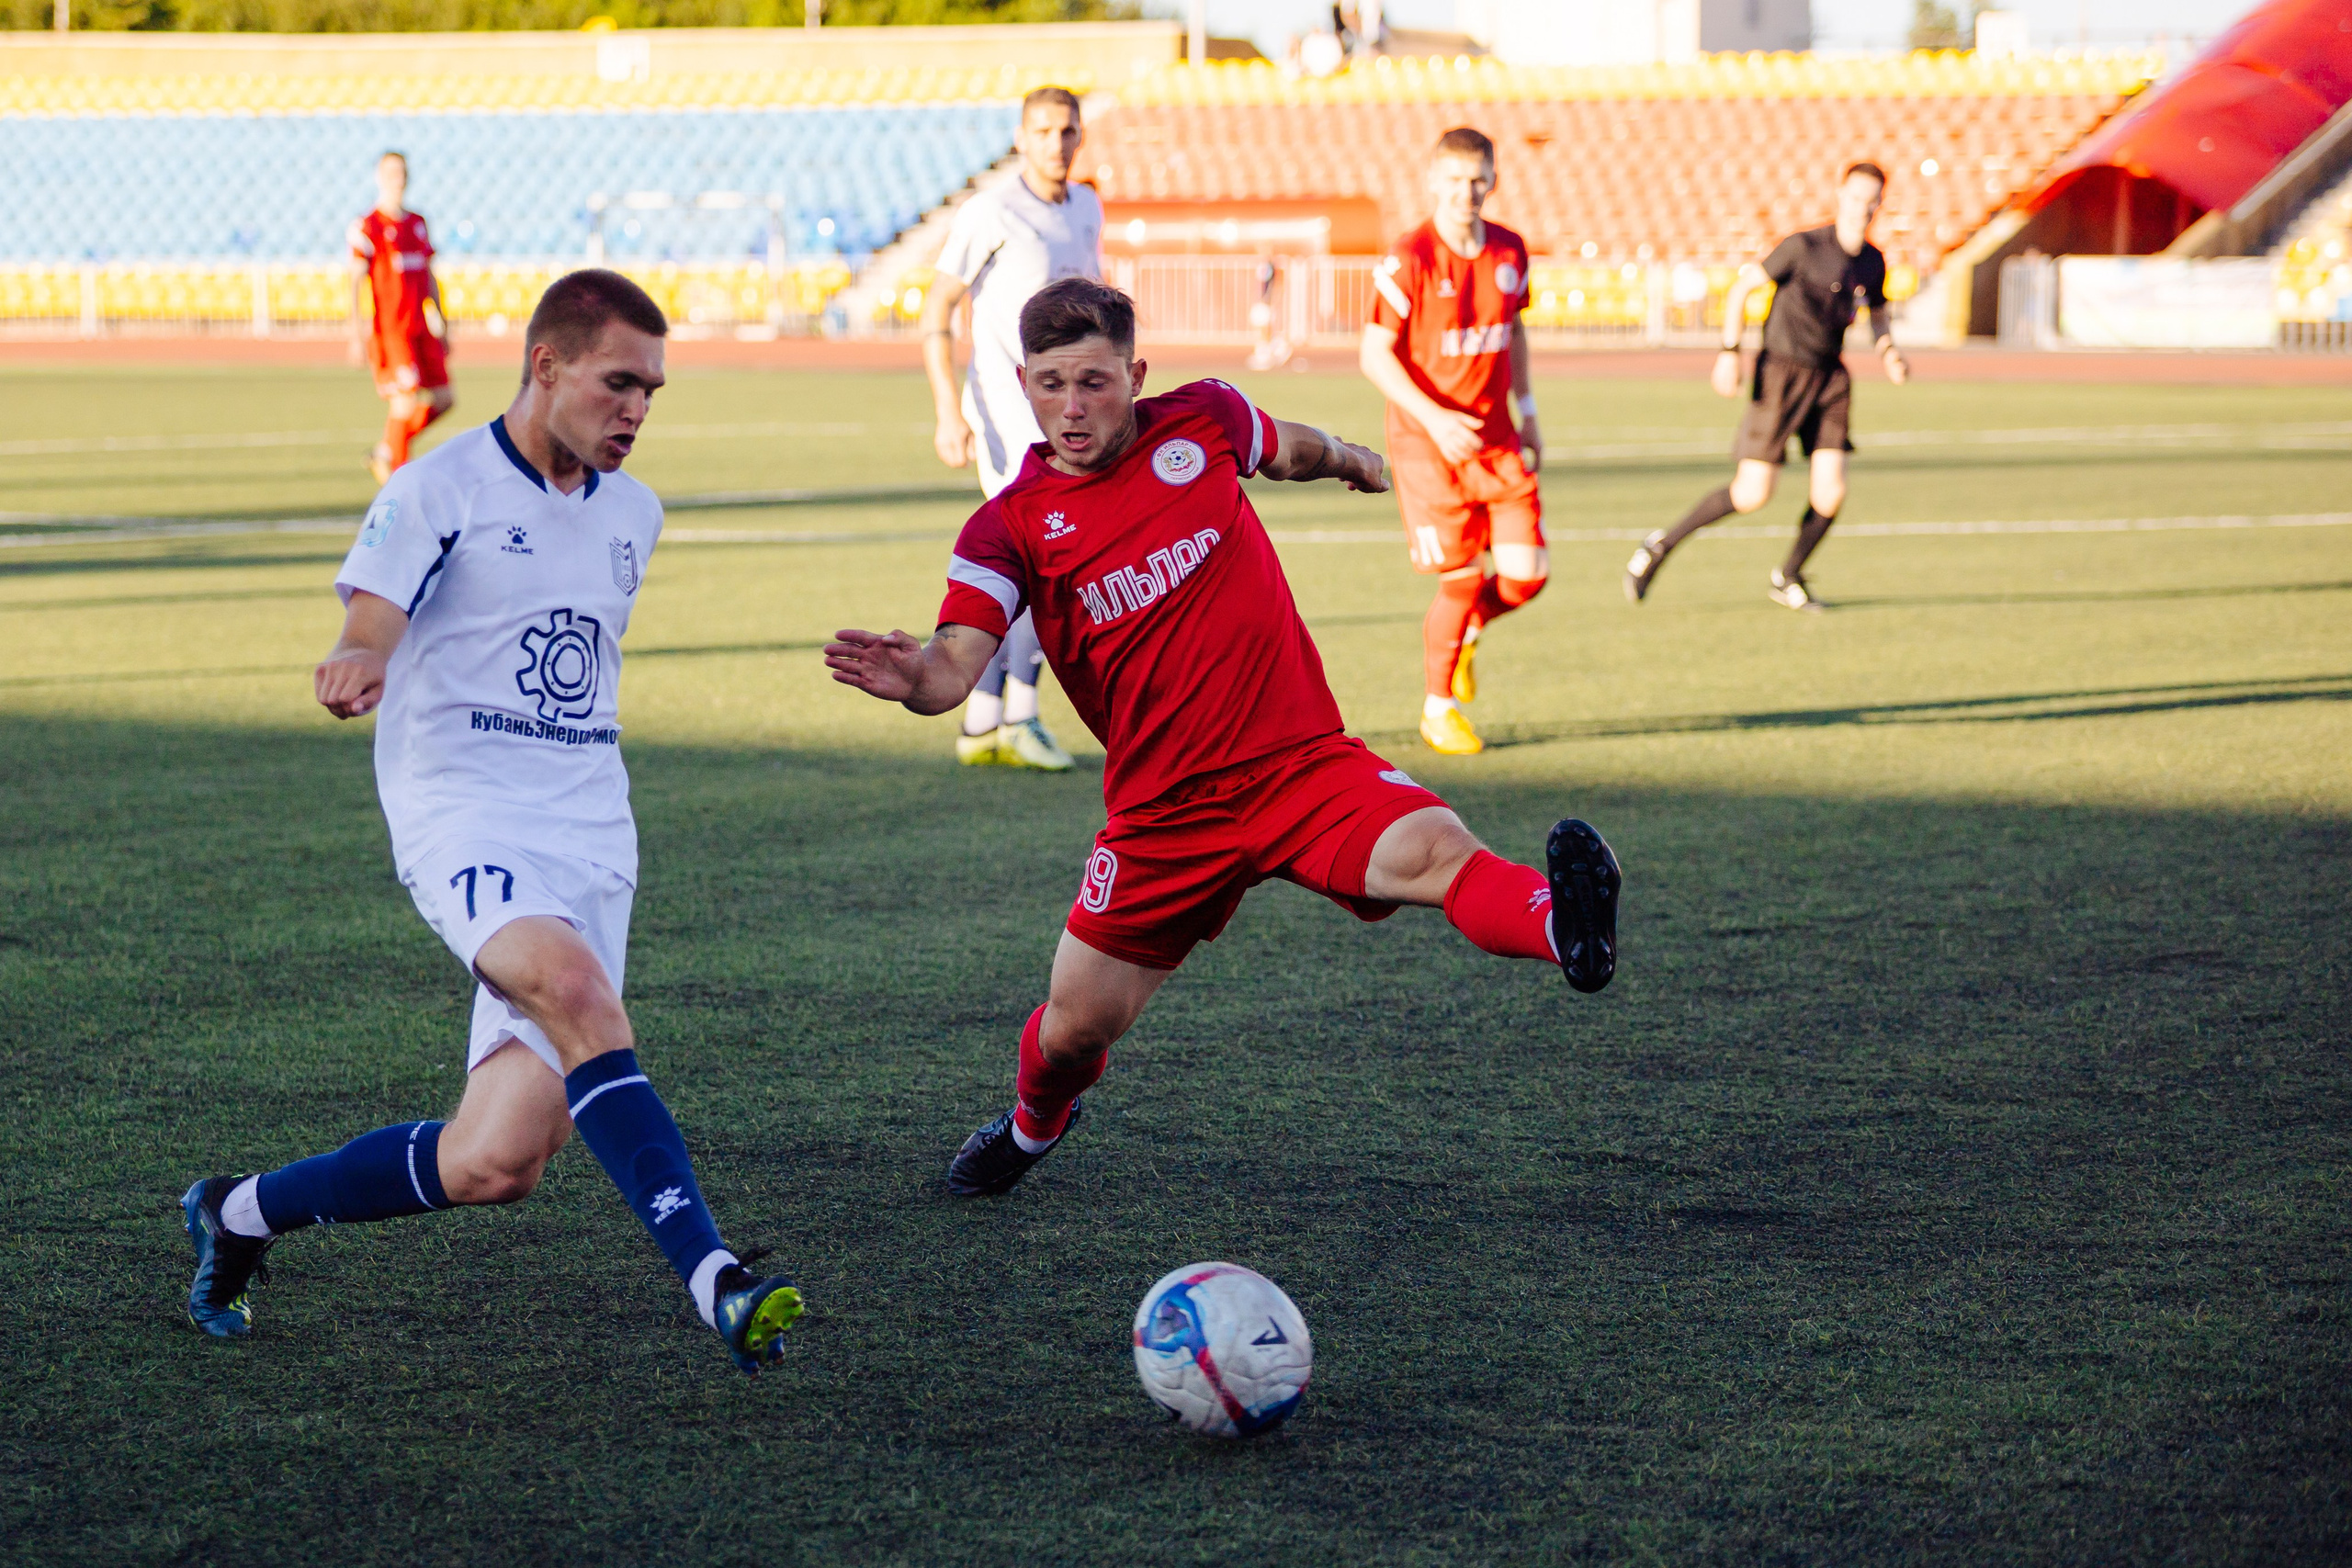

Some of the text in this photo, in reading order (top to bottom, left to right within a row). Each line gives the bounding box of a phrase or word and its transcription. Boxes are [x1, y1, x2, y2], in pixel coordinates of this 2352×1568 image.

[1044, 524, 1077, 540] KELME
[501, 545, 534, 555] KELME
[449, 864, 514, 922] 77
[654, 1197, 691, 1224] KELME
